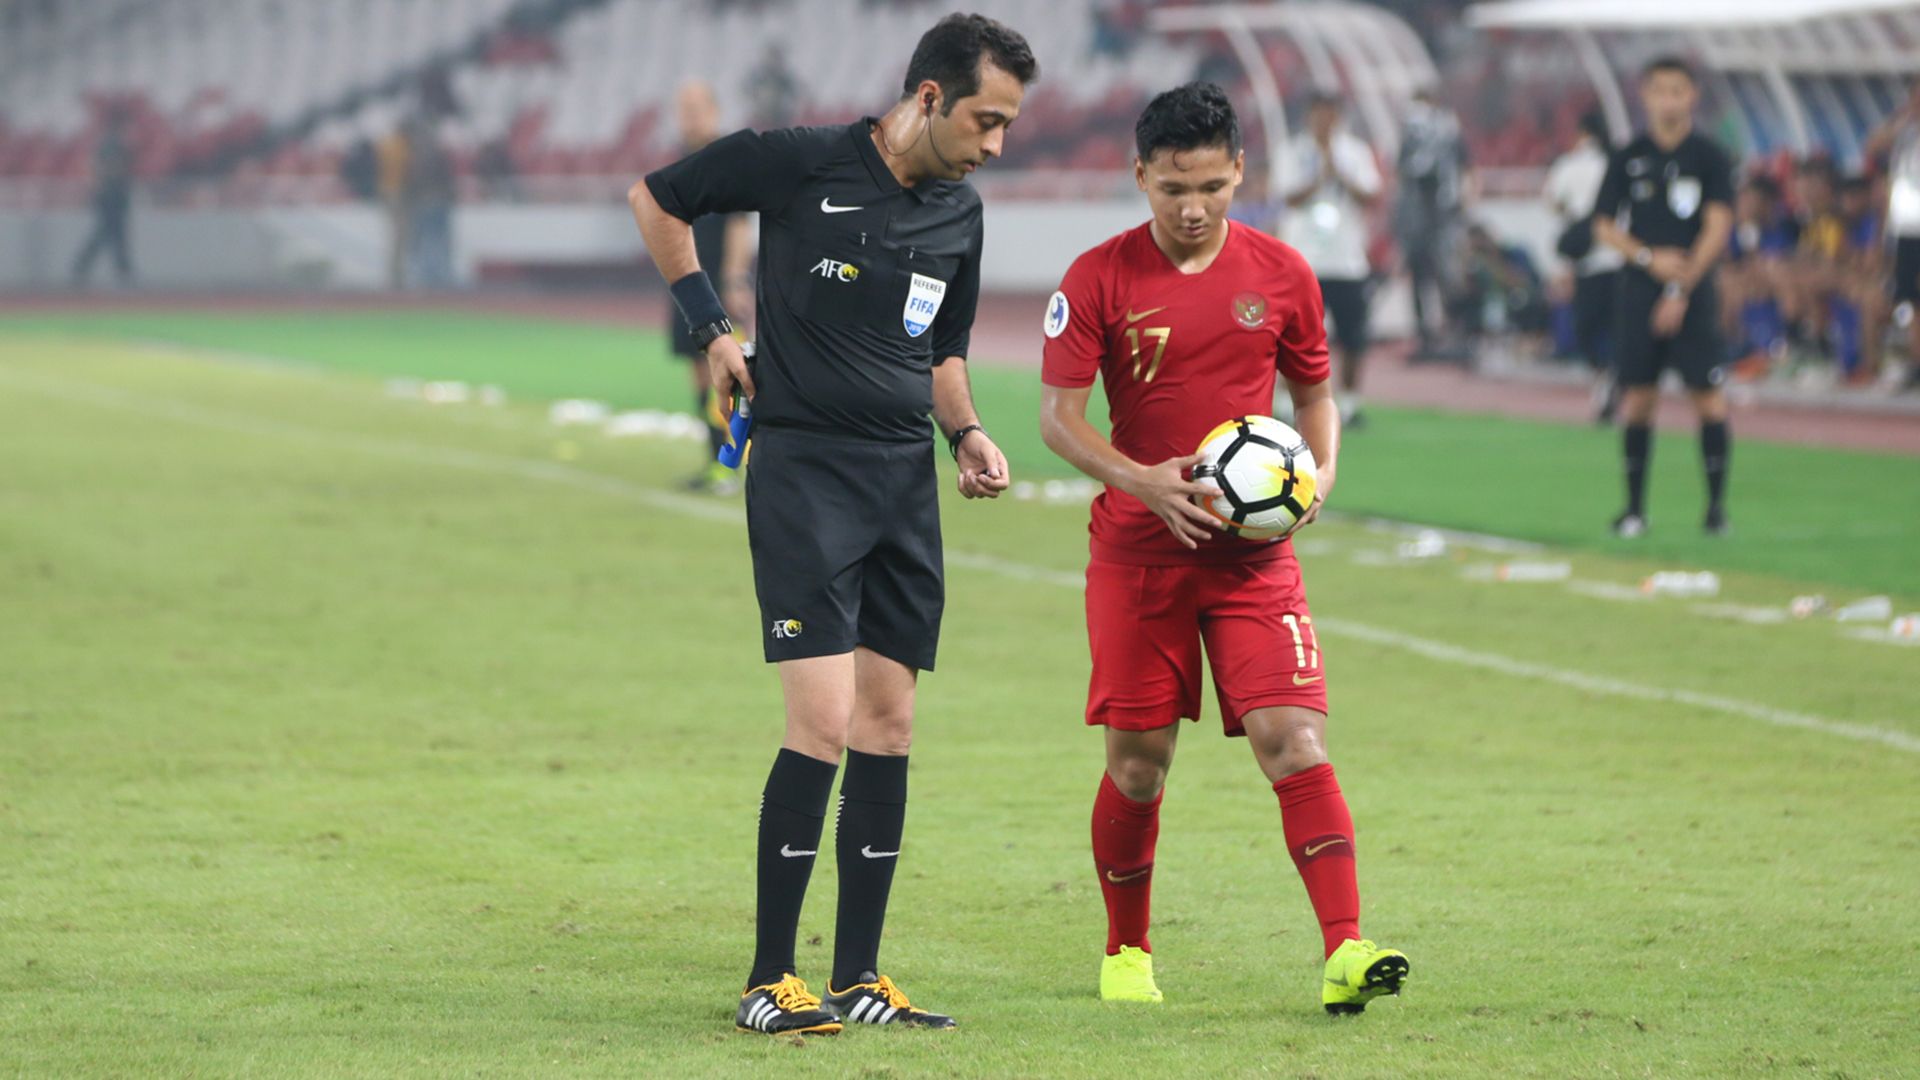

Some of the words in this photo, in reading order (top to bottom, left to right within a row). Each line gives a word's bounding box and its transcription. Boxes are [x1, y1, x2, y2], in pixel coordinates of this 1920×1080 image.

[810, 258, 859, 282] AFC
[913, 278, 943, 294] REFEREE
[909, 297, 934, 315] FIFA
[1125, 327, 1171, 383] 17
